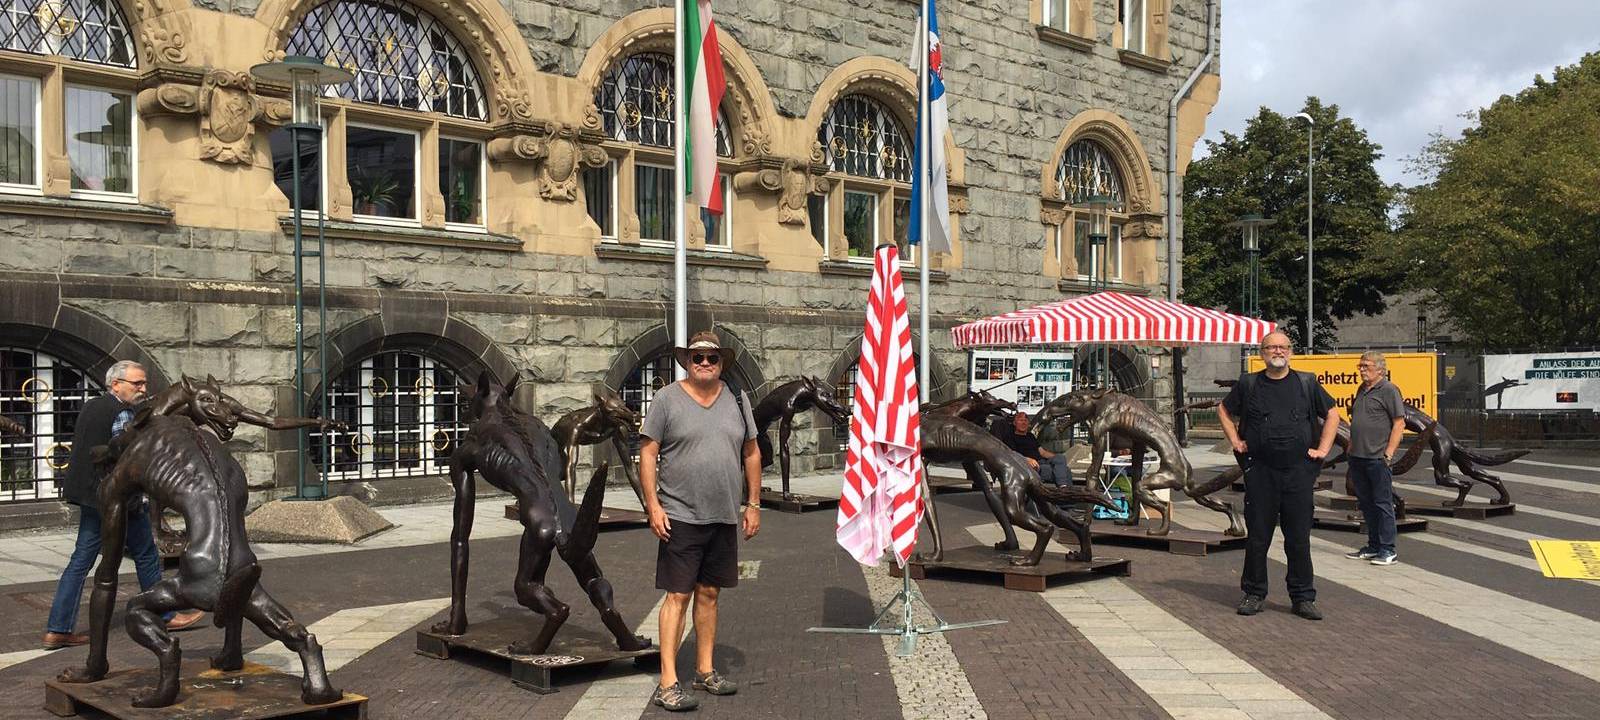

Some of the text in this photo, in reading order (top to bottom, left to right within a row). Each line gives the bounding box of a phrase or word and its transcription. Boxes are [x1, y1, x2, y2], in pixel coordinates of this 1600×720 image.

[296, 323, 301, 332] 3
[1032, 361, 1045, 369] HASS
[1540, 359, 1600, 368] ANLASS DER AU
[1317, 370, 1358, 385] ehetzt
[1535, 371, 1550, 379] DIE
[1553, 370, 1577, 379] WÖLFE
[1403, 394, 1425, 408] en!
